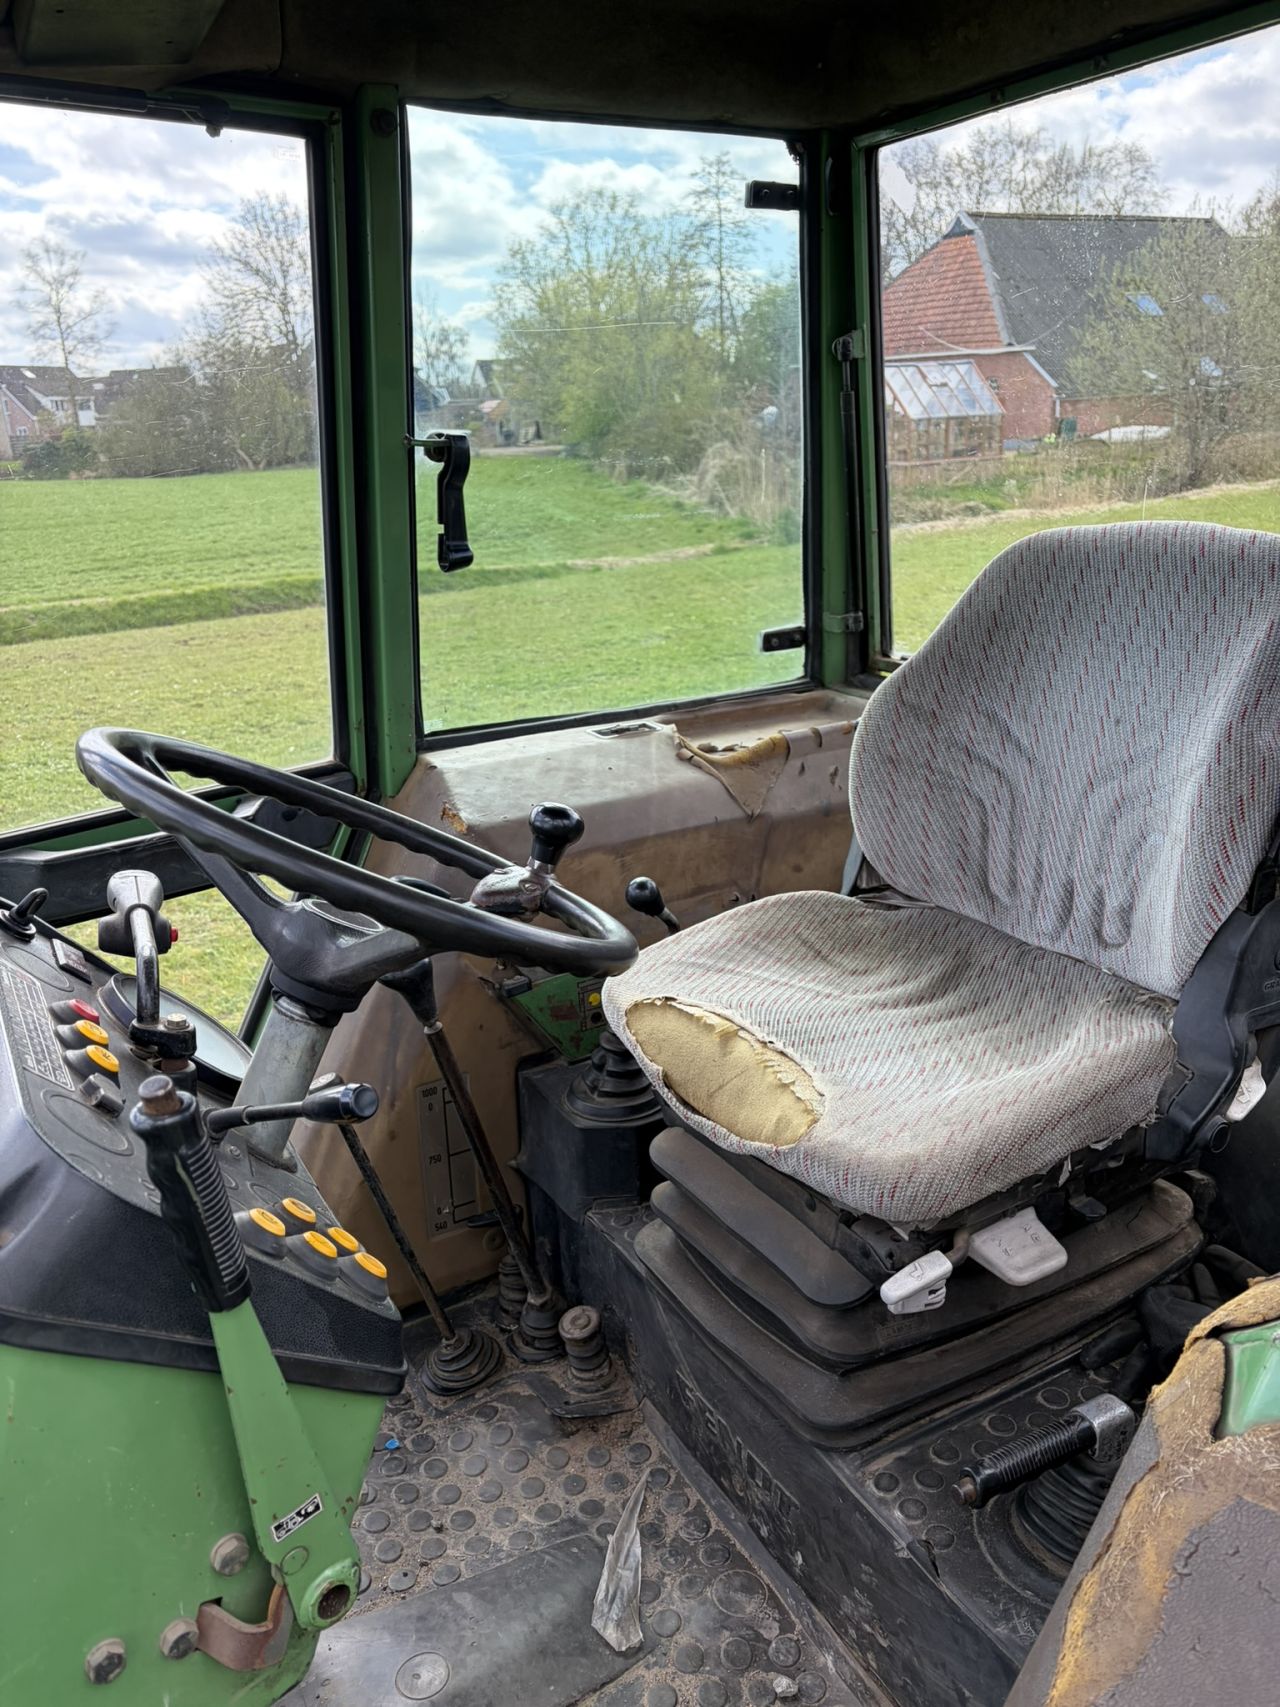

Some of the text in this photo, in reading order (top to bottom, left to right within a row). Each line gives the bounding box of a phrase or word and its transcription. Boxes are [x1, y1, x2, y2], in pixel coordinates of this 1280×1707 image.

[422, 1086, 437, 1098] 1000
[428, 1102, 433, 1111] 0
[429, 1154, 442, 1166] 750
[437, 1207, 442, 1215] 0
[434, 1221, 447, 1231] 540
